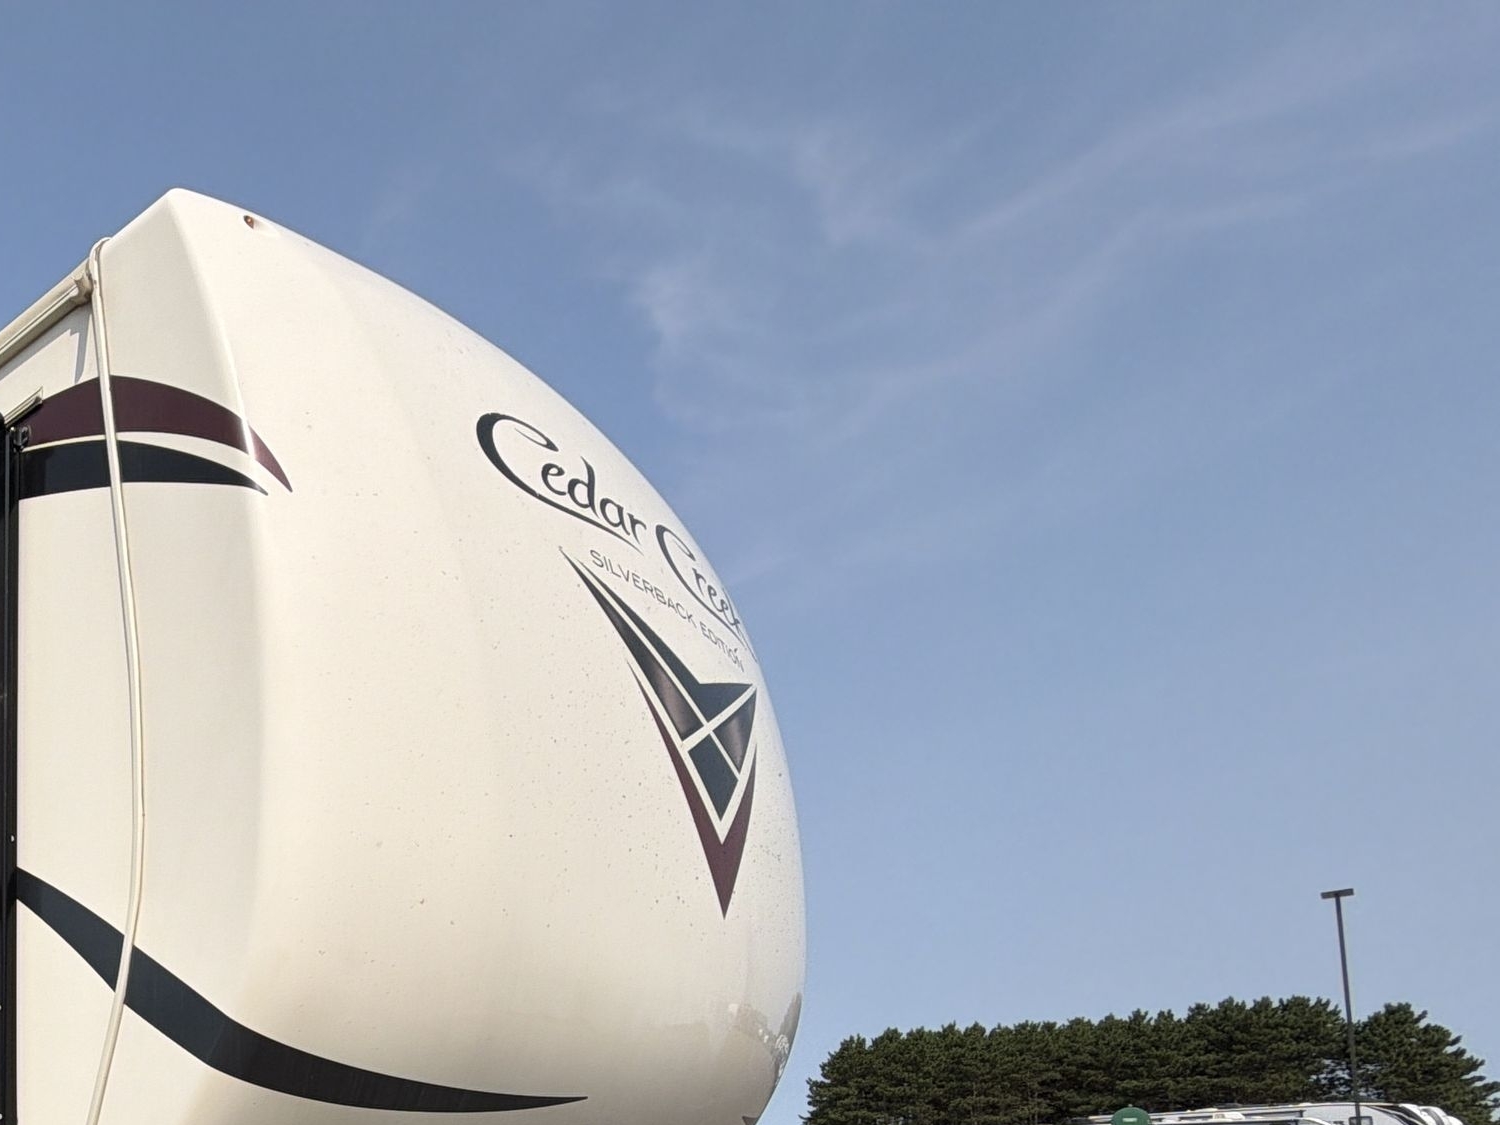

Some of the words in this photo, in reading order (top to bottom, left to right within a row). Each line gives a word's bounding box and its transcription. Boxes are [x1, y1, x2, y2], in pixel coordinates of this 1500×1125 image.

[476, 412, 647, 557] Cedar
[656, 524, 758, 663] Creek
[589, 548, 698, 629] SILVERBACK
[699, 621, 745, 673] EDITION
